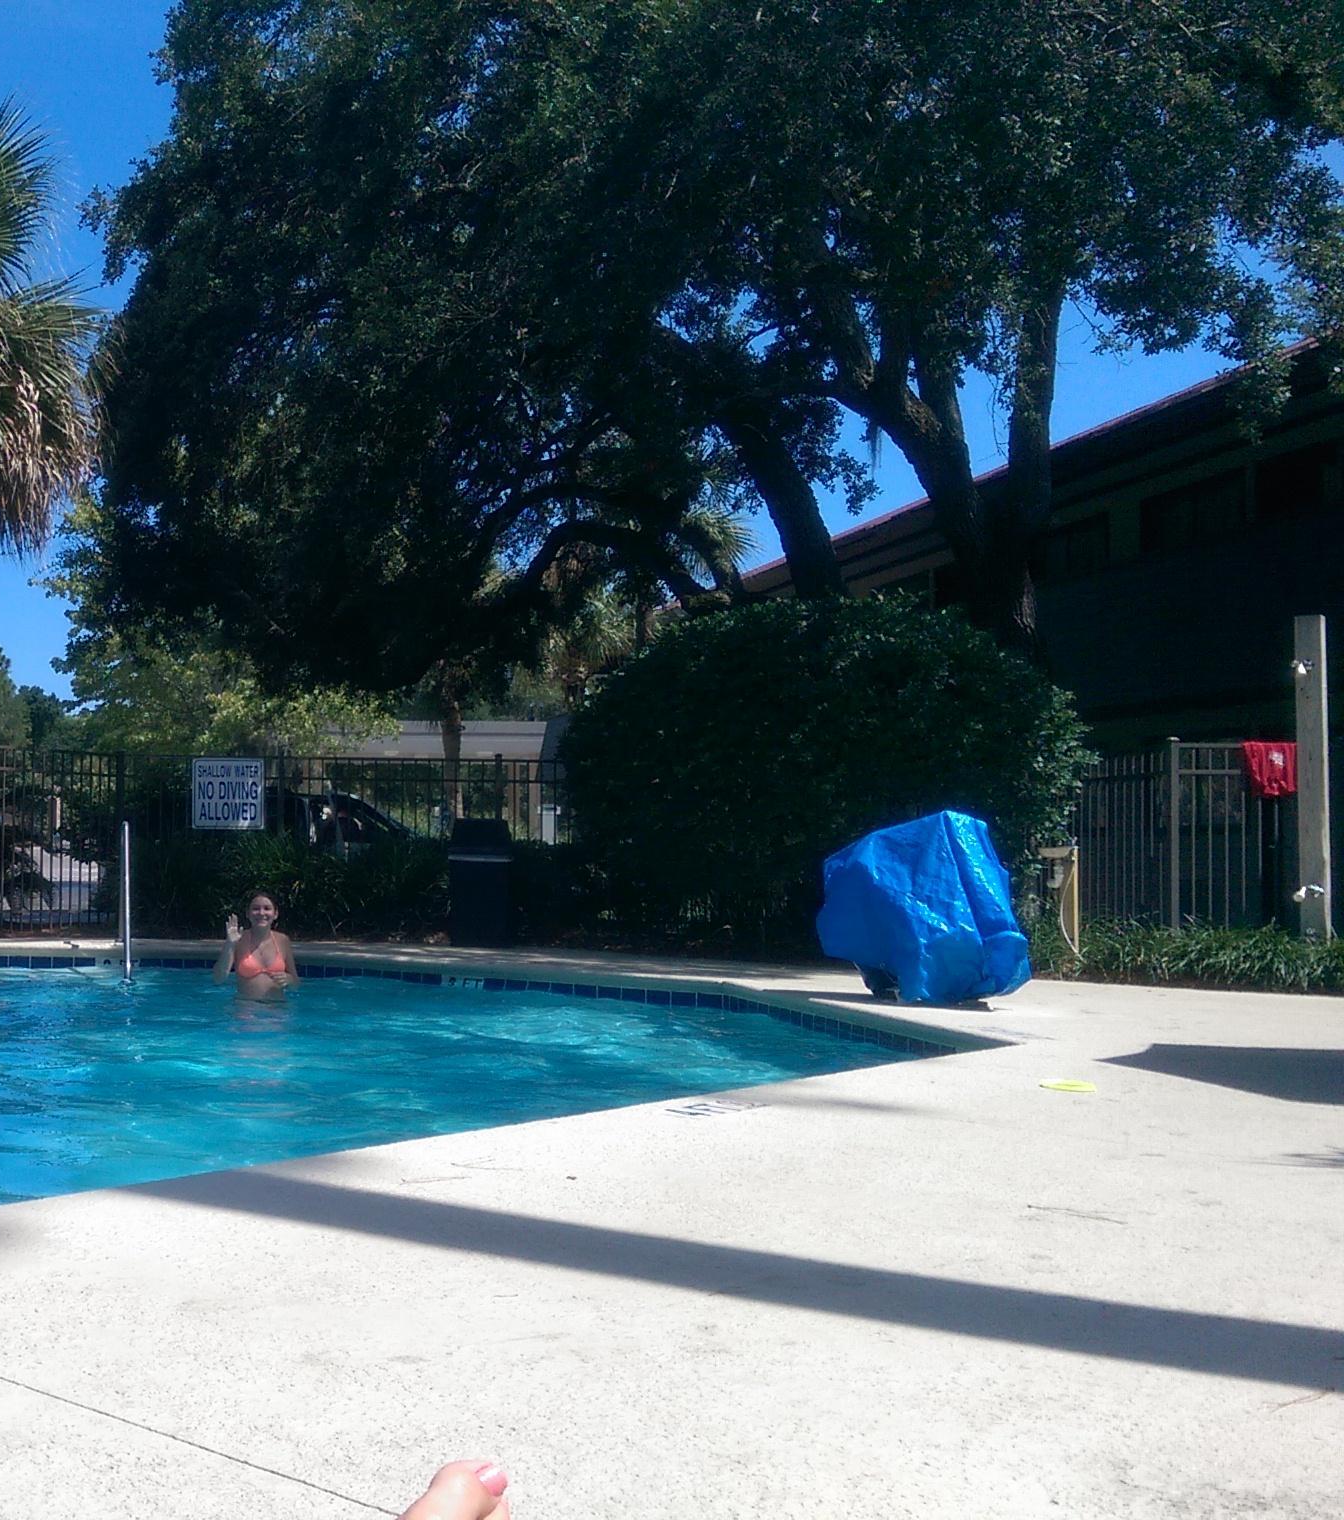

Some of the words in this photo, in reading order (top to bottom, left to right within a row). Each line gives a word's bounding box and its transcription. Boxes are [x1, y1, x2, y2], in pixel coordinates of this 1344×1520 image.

[197, 765, 231, 778] SHALLOW
[234, 765, 259, 778] WATER
[197, 781, 215, 800] NO
[218, 781, 258, 800] DIVING
[199, 802, 257, 821] ALLOWED
[462, 977, 483, 988] FT
